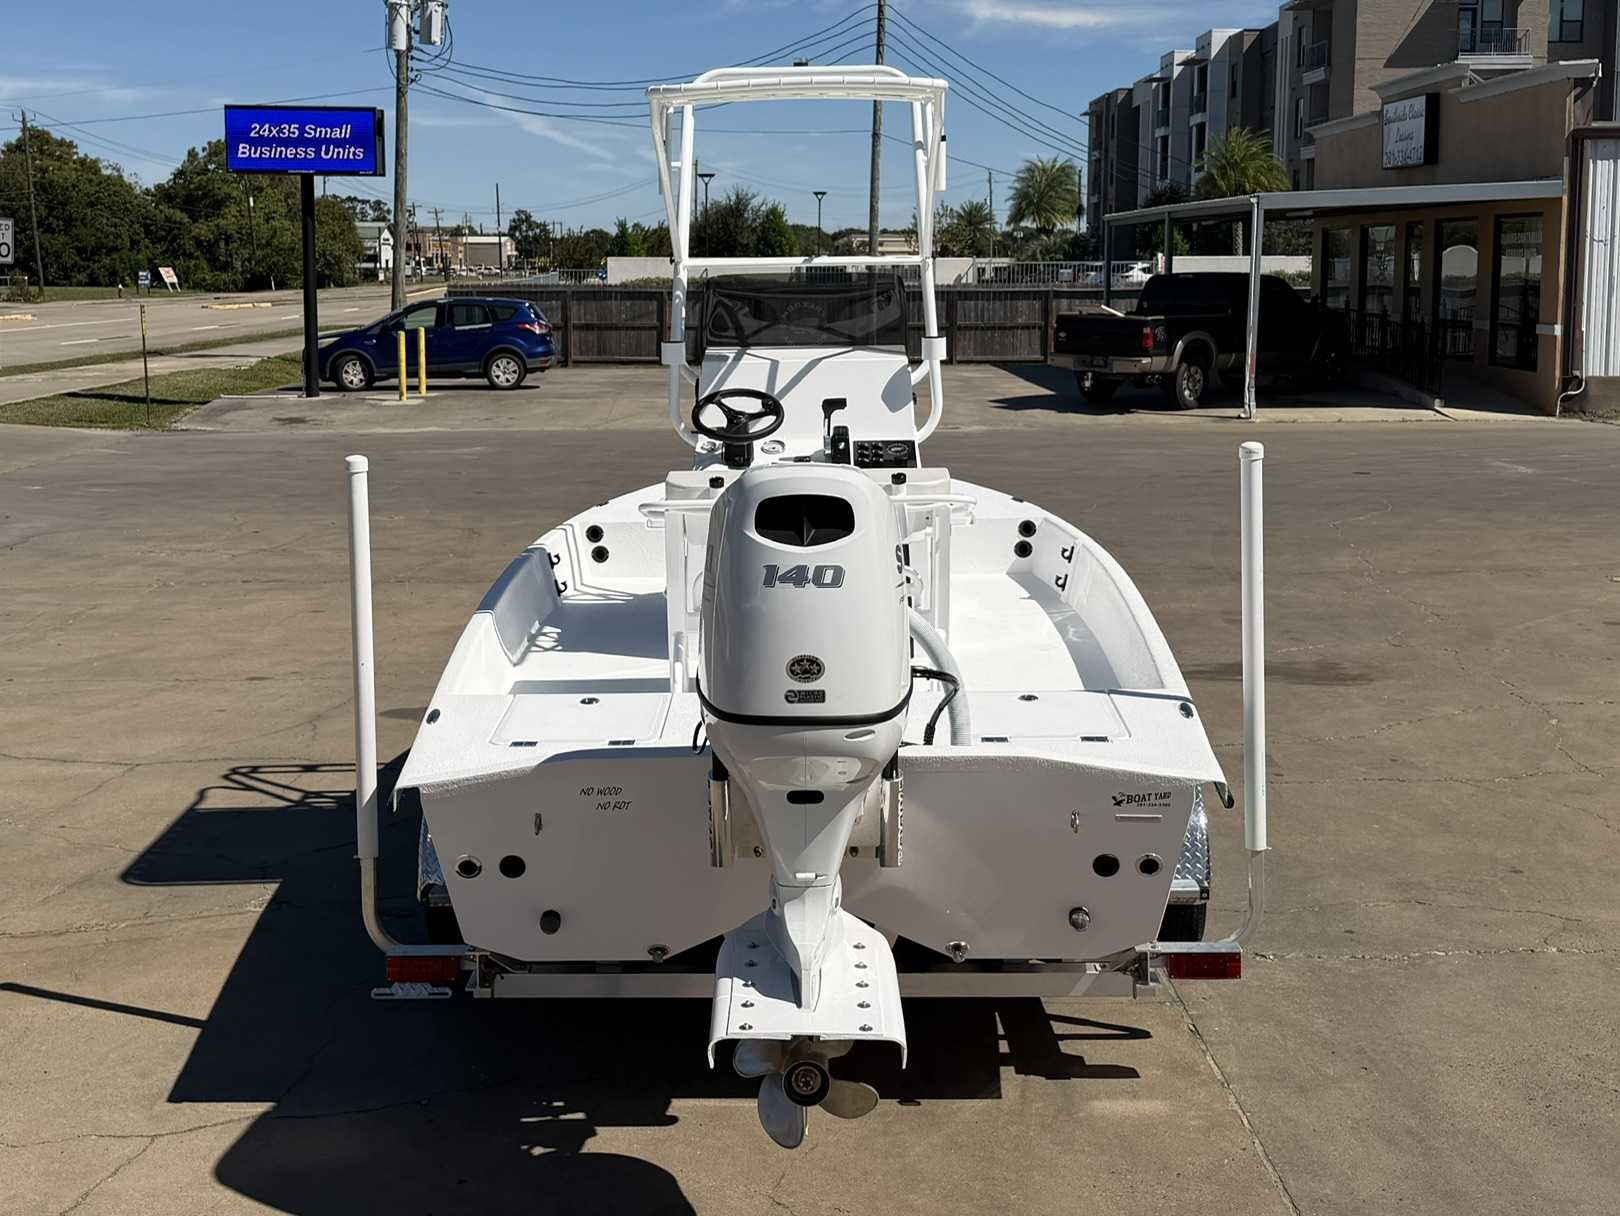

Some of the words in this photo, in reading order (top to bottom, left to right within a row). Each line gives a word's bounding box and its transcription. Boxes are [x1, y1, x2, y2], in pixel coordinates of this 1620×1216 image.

[250, 123, 299, 138] 24x35
[304, 124, 351, 139] Small
[237, 143, 315, 159] Business
[320, 144, 364, 160] Units
[762, 564, 846, 588] 140
[580, 787, 594, 796] NO
[597, 786, 623, 796] WOOD
[1127, 793, 1152, 804] BOAT
[596, 801, 611, 810] NO
[612, 800, 632, 811] ROT
